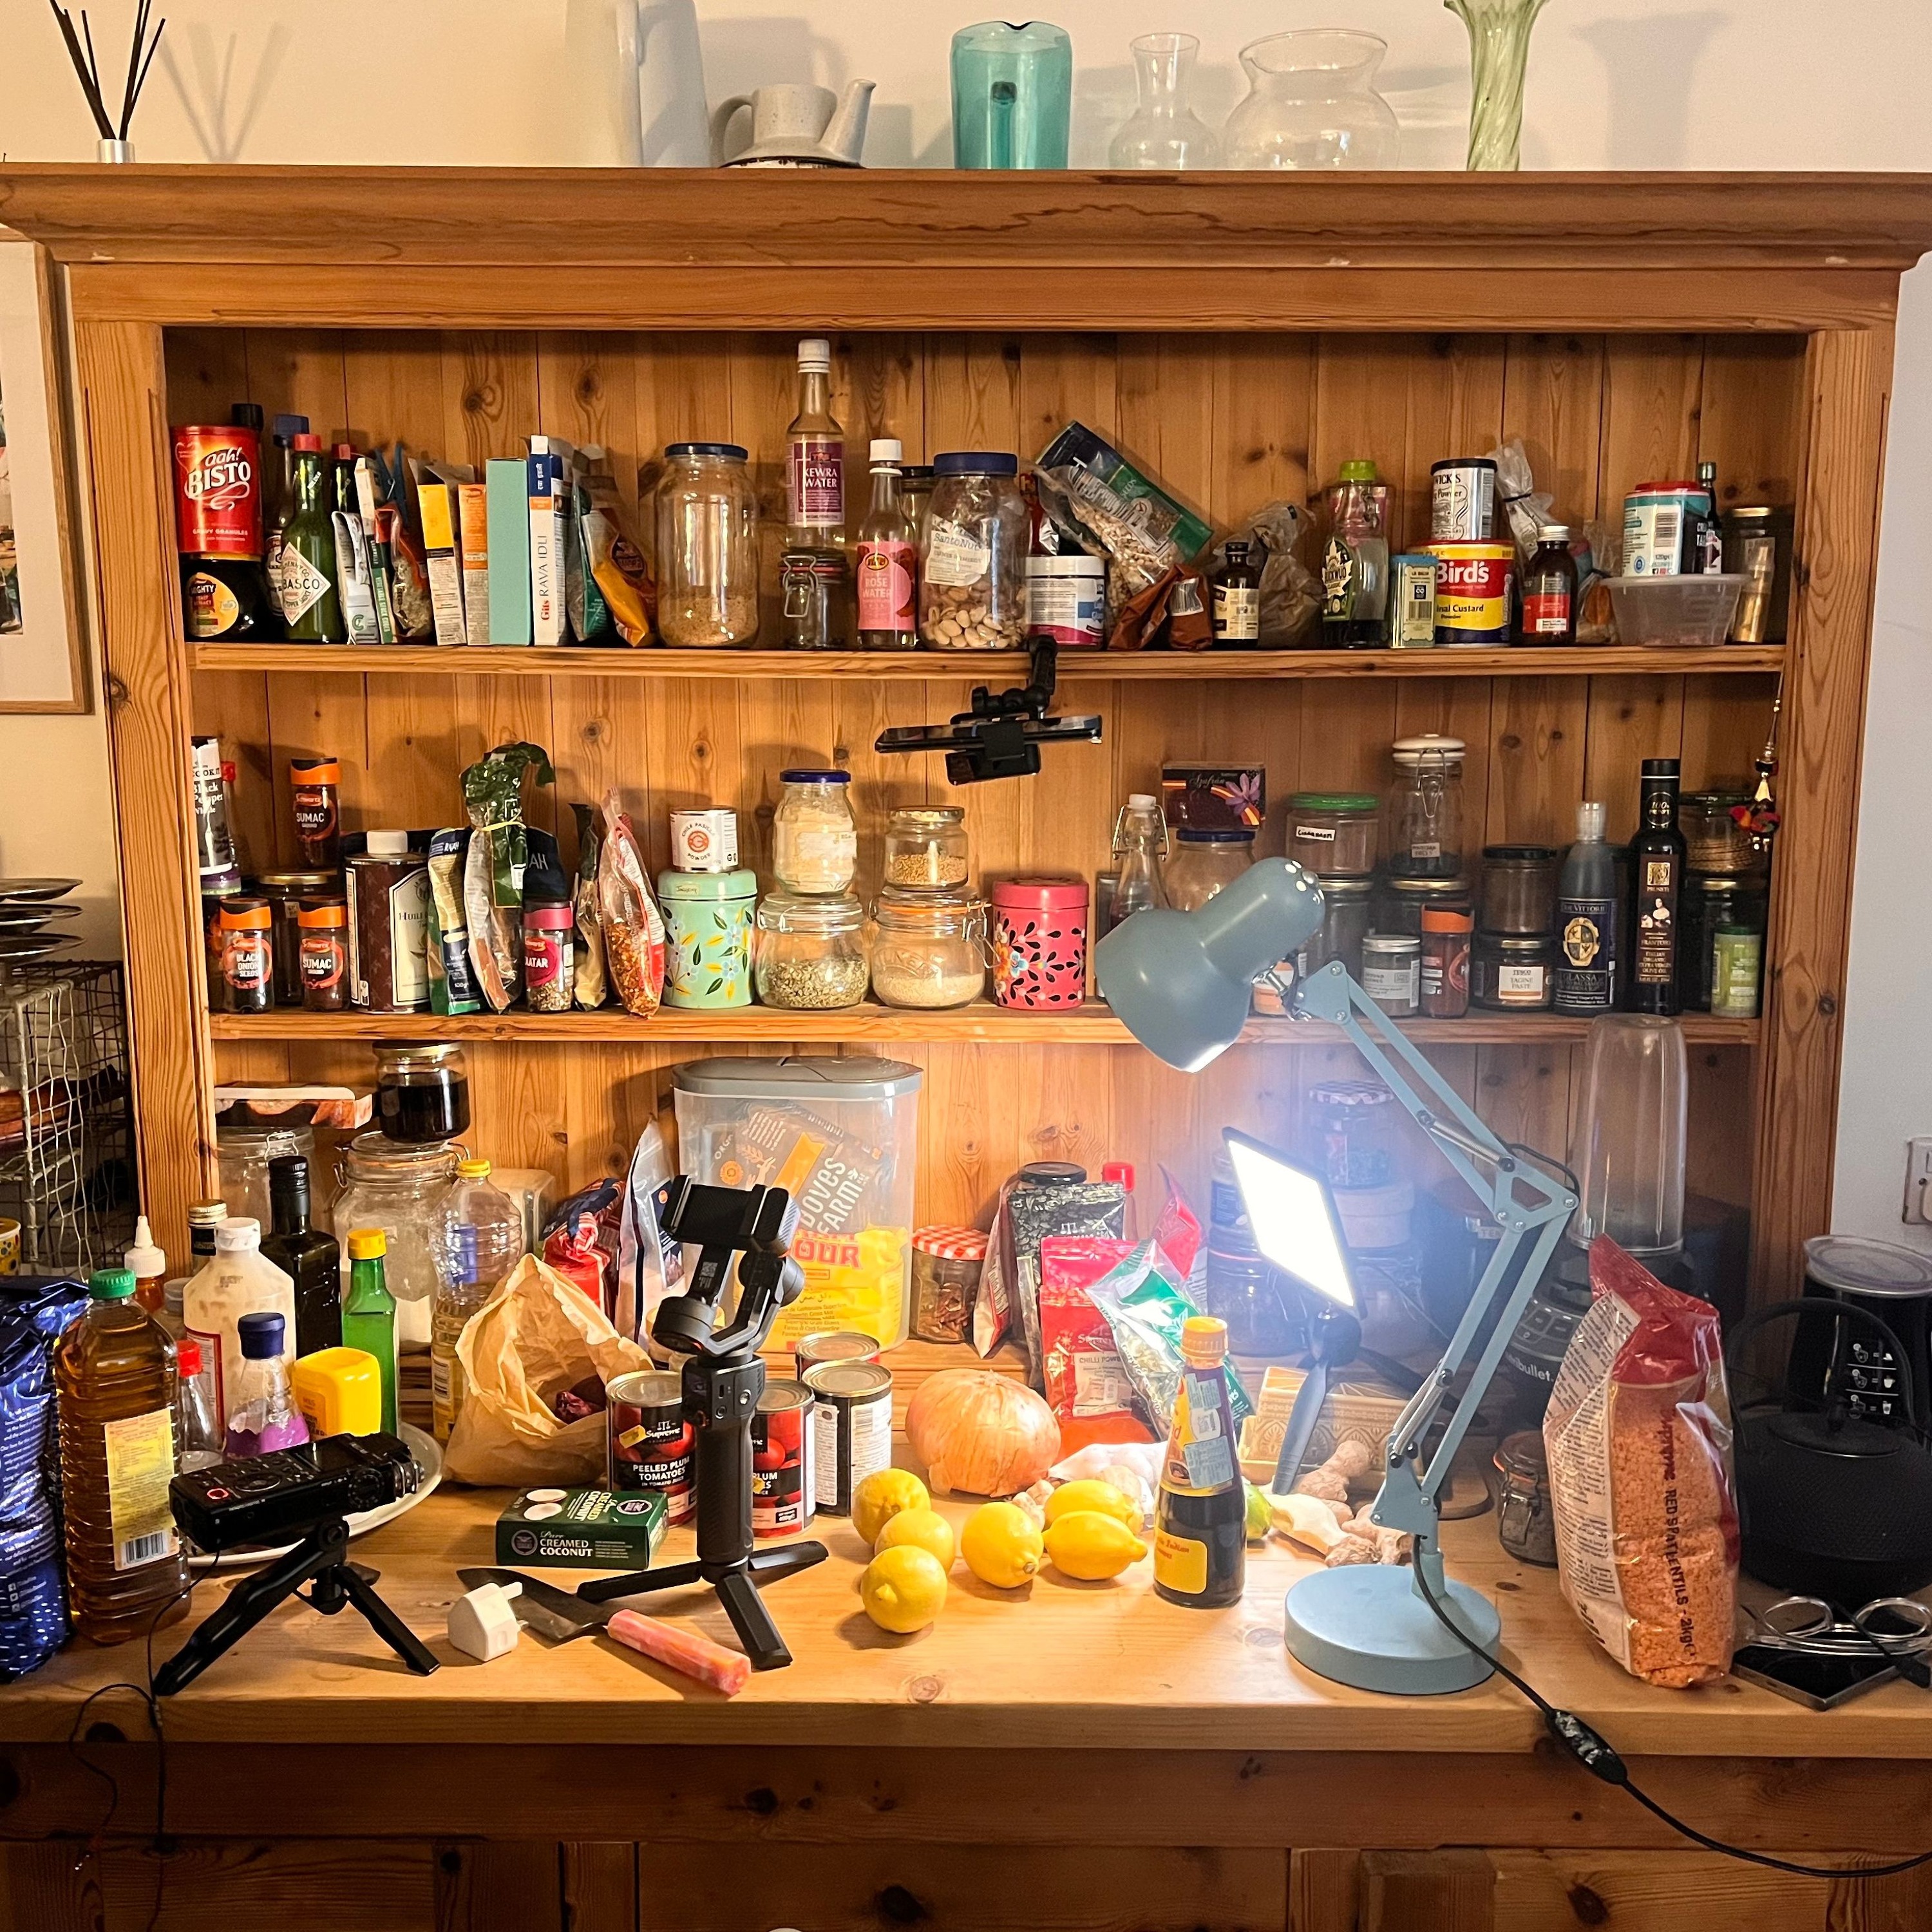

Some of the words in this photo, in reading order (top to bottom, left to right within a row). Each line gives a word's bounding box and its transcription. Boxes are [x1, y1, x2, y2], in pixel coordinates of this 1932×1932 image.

[205, 447, 242, 467] aah!
[188, 461, 251, 499] BISTO
[804, 468, 837, 477] KEWRA
[804, 478, 837, 488] WATER
[537, 535, 548, 558] IDLI
[1437, 560, 1490, 583] Bird's
[283, 578, 320, 590] BASCO
[538, 564, 549, 596] RAVA
[865, 578, 888, 587] ROSE
[540, 600, 550, 620] Gits
[1452, 604, 1484, 612] Custard
[296, 812, 325, 822] SUMAC
[303, 958, 332, 969] SUMAC
[817, 1180, 864, 1235] FARM
[792, 1237, 862, 1270] OUR
[646, 1427, 681, 1439] Supreme
[633, 1464, 668, 1473] PEELED
[669, 1455, 690, 1470] PLUM
[639, 1466, 686, 1481] TOMATOES
[1665, 1489, 1678, 1514] RED
[540, 1537, 589, 1549] CREAMED
[540, 1547, 594, 1557] COCONUT
